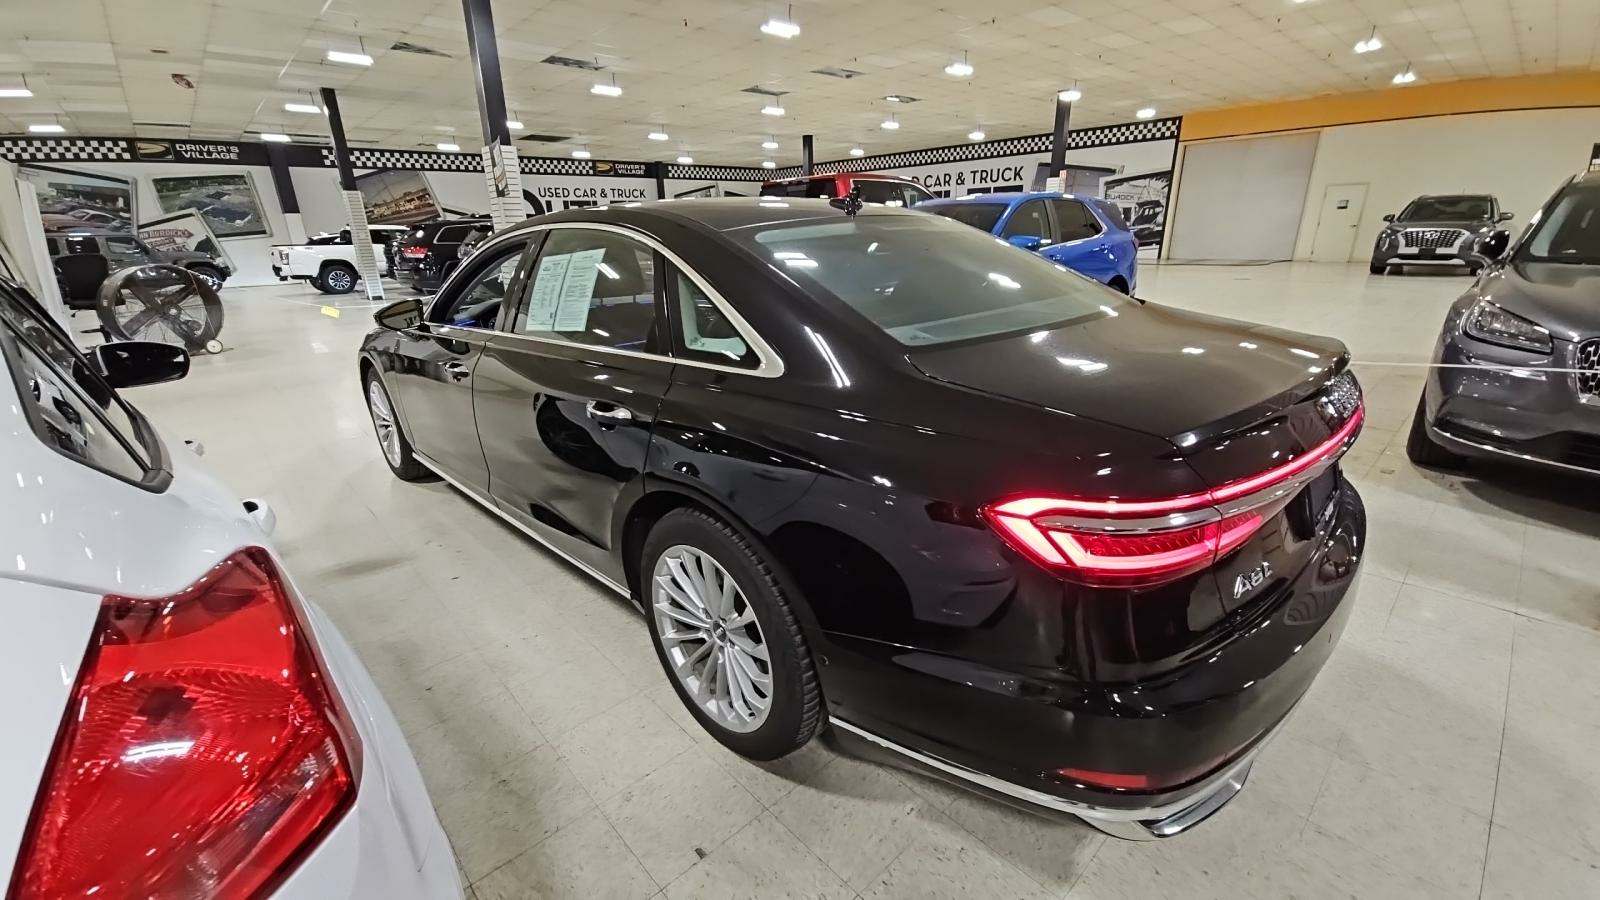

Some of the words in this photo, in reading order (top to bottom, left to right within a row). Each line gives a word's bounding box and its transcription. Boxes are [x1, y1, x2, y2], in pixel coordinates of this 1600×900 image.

[175, 144, 239, 153] DRIVER'S
[181, 151, 239, 159] VILLAGE
[923, 173, 952, 188] CAR
[955, 171, 966, 186] &
[970, 166, 1024, 185] TRUCK
[538, 187, 570, 198] USED
[573, 187, 597, 198] CAR
[599, 188, 608, 198] &
[610, 188, 646, 199] TRUCK
